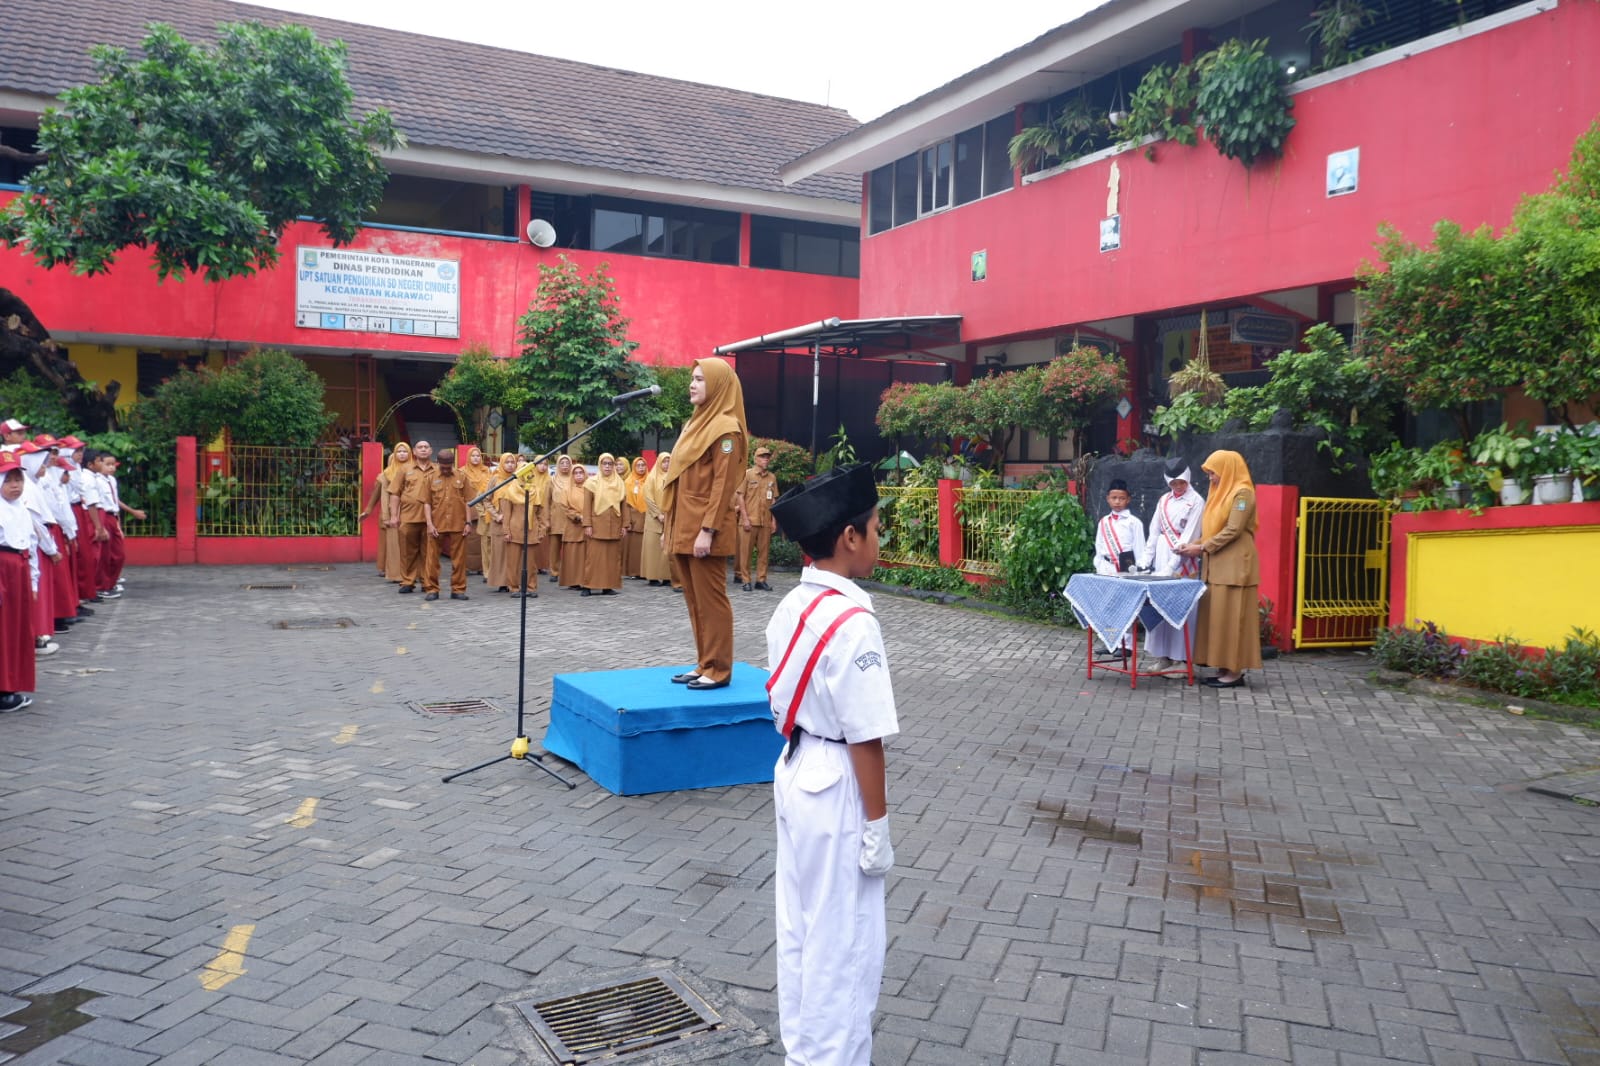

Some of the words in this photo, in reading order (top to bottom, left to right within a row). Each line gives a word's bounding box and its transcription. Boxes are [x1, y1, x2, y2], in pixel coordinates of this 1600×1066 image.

[320, 251, 369, 262] PEMERINTAH
[392, 258, 436, 268] TANGERANG
[333, 262, 362, 272] DINAS
[366, 265, 423, 277] PENDIDIKAN
[299, 269, 313, 281] UPT
[314, 271, 342, 284] SATUAN
[343, 274, 386, 288] PENDIDIKAN
[387, 278, 397, 289] SD
[398, 280, 423, 291] NEGERI
[324, 285, 382, 297] KECAMATAN
[384, 290, 433, 301] KARAWACI
